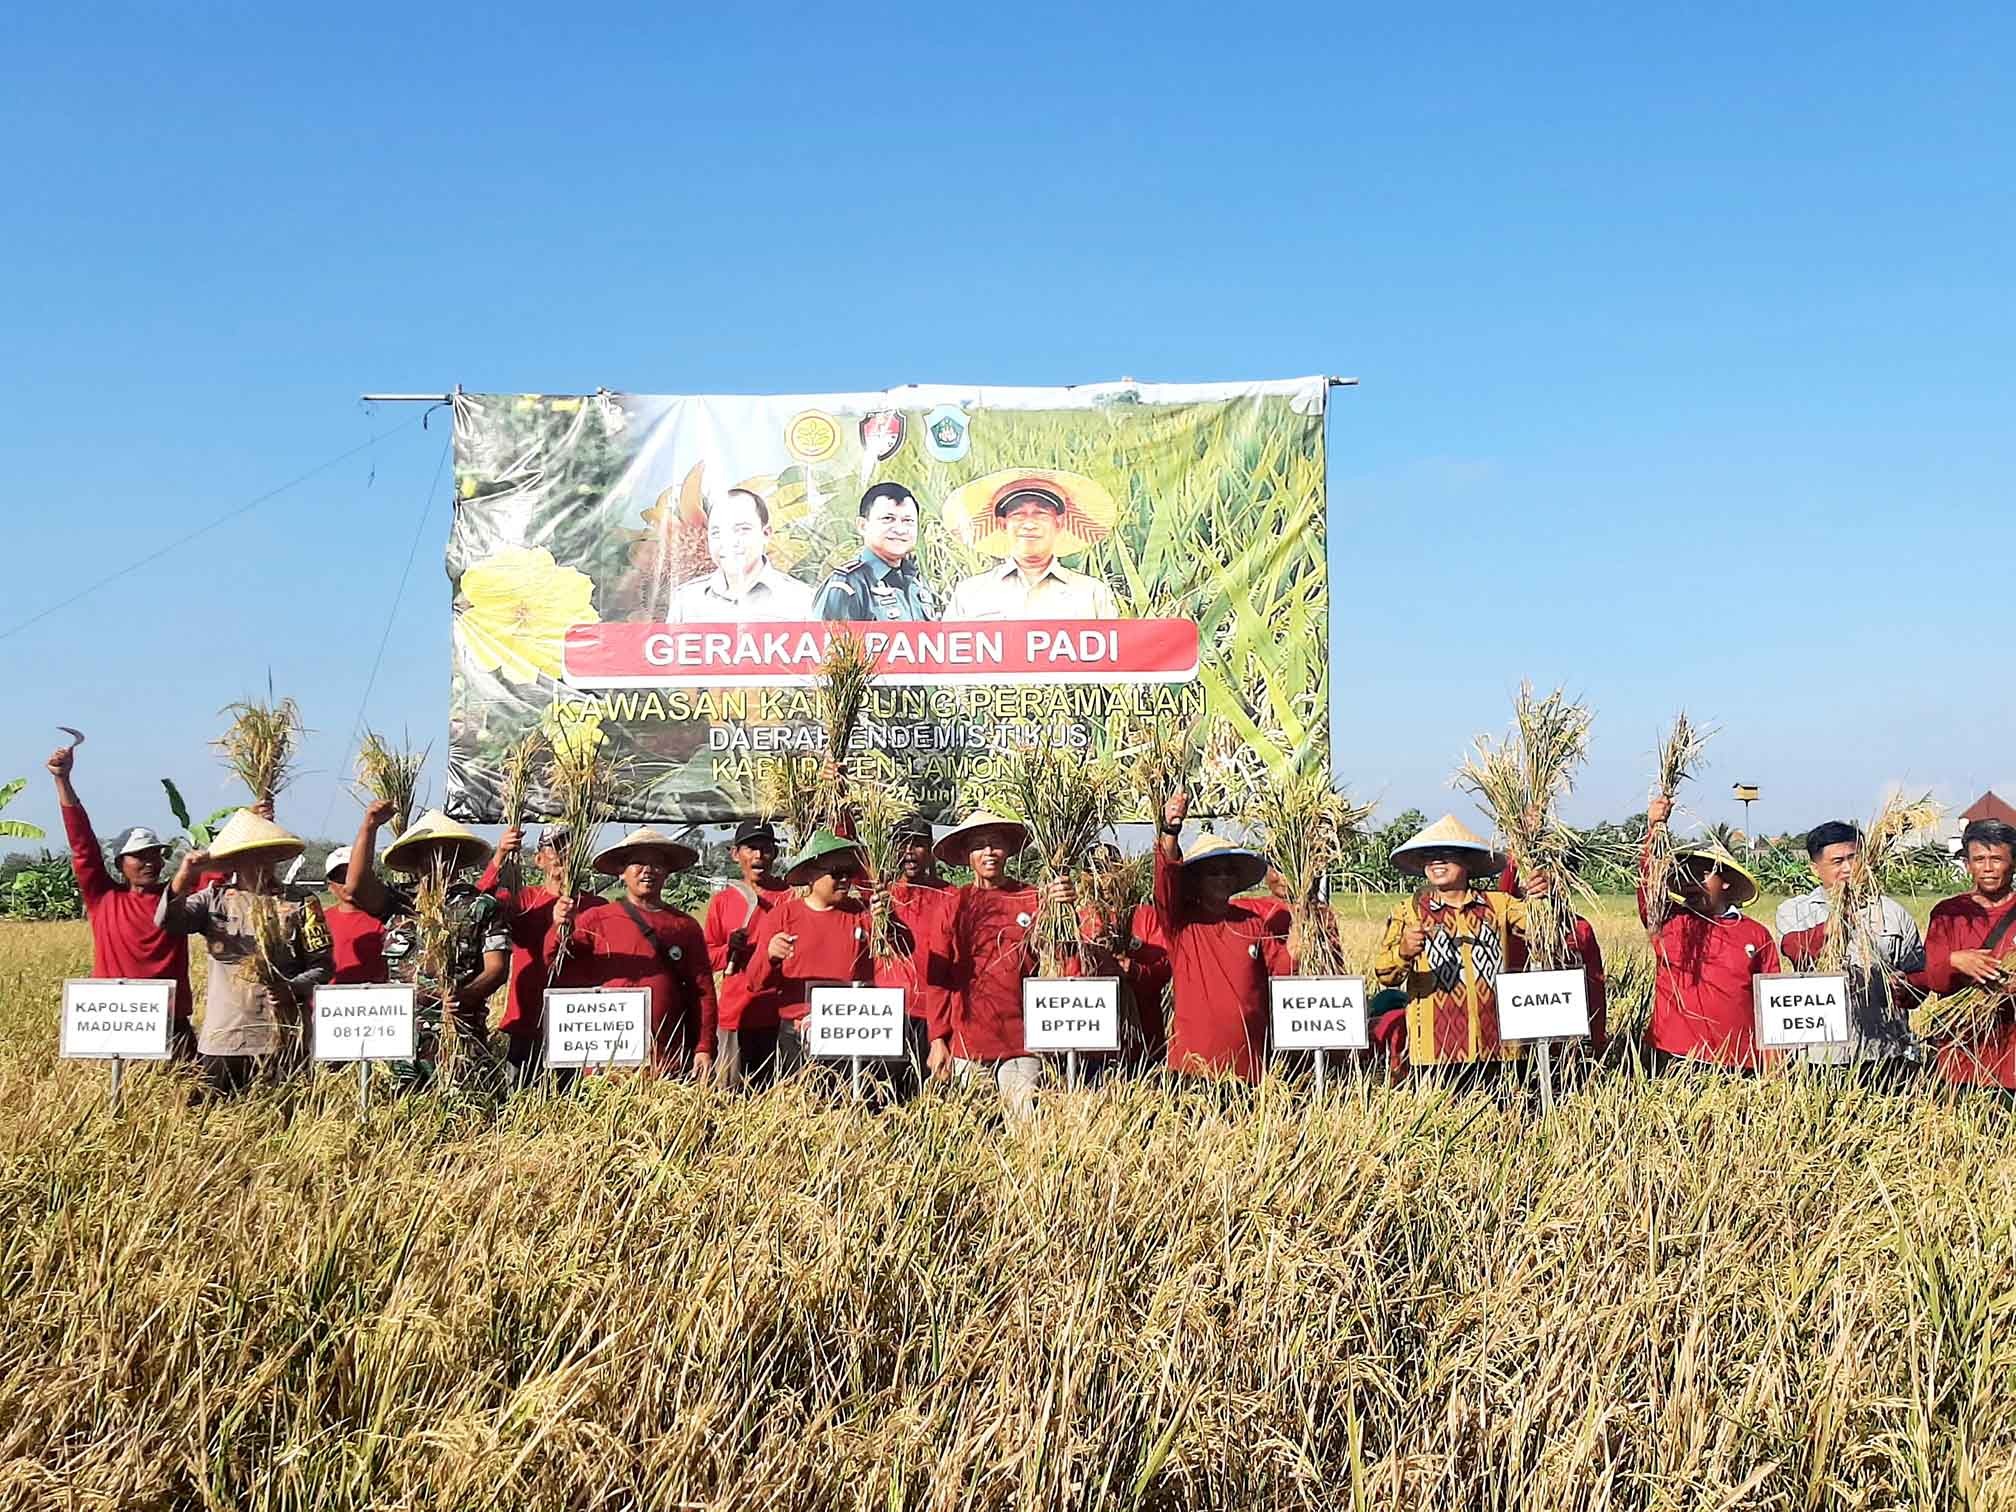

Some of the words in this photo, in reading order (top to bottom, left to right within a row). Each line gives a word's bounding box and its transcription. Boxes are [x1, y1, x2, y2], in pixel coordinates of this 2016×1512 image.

[864, 631, 1002, 664] PANEN
[1026, 629, 1119, 663] PADI
[552, 690, 747, 722] KAWASAN
[969, 685, 1207, 719] PERAMALAN
[849, 724, 987, 751] ENDEMIS
[994, 722, 1088, 749] TIKUS
[1035, 996, 1106, 1009] KEPALA
[1282, 996, 1354, 1009] KEPALA
[1511, 991, 1572, 1008] CAMAT
[1770, 993, 1836, 1008] KEPALA
[75, 1002, 159, 1013] KAPOLSEK
[321, 1005, 407, 1018] DANRAMIL
[566, 1002, 624, 1014] DANSAT
[821, 1004, 893, 1016] KEPALA
[77, 1021, 156, 1032] MADURAN
[558, 1020, 635, 1032] INTELMED
[1041, 1019, 1100, 1032] BPTPH
[1291, 1019, 1347, 1033] DINAS
[1783, 1015, 1825, 1030] DESA
[333, 1025, 396, 1038] 0812/16
[820, 1027, 893, 1040] BBPOPT
[563, 1039, 599, 1051] BAIS
